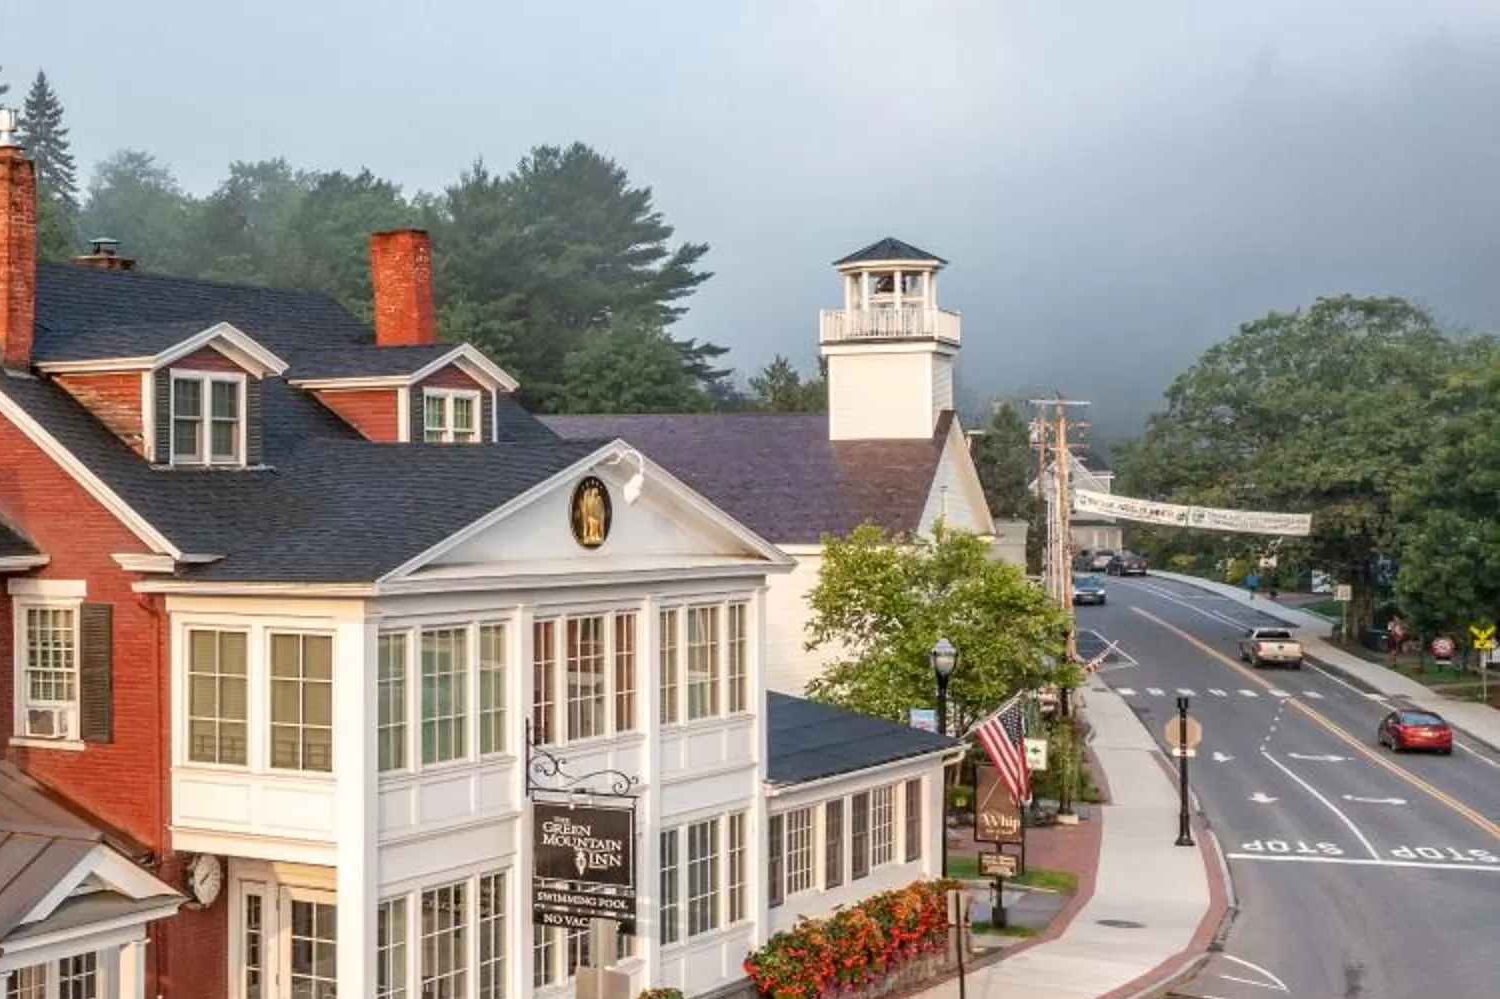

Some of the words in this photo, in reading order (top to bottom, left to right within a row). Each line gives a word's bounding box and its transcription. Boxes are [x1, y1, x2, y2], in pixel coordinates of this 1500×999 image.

[542, 821, 591, 836] GREEN
[980, 813, 1020, 833] Whip
[542, 833, 622, 851] MOUNTAIN
[1241, 839, 1345, 856] STOP
[589, 852, 622, 868] INN
[1391, 844, 1500, 863] STOP
[537, 891, 597, 906] SWIMMING
[598, 897, 628, 910] POOL
[543, 913, 563, 924] NO
